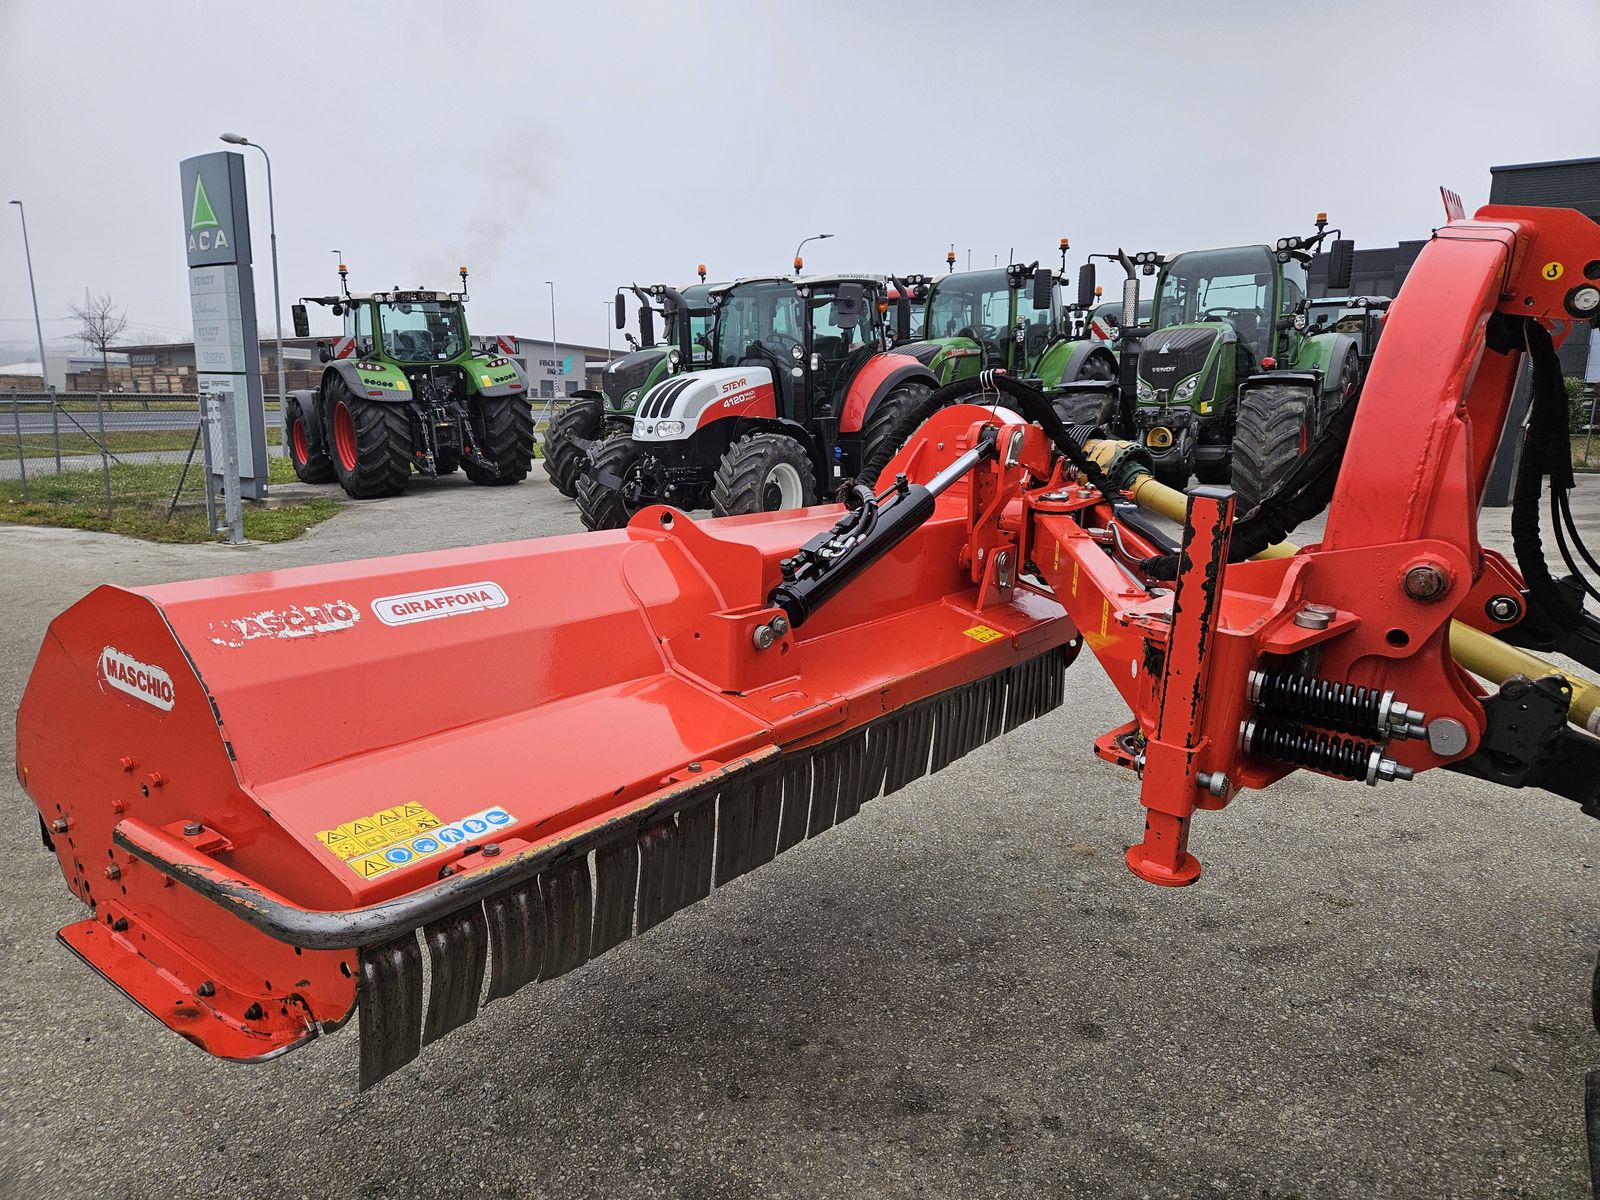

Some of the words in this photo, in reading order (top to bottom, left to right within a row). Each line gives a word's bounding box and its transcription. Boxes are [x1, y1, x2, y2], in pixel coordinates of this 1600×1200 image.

[188, 229, 229, 253] ACA
[722, 378, 747, 393] STEYR
[723, 394, 745, 408] 4120
[390, 590, 494, 616] GIRAFFONA
[228, 604, 354, 637] ASCHIO
[105, 656, 172, 703] MASCHIO
